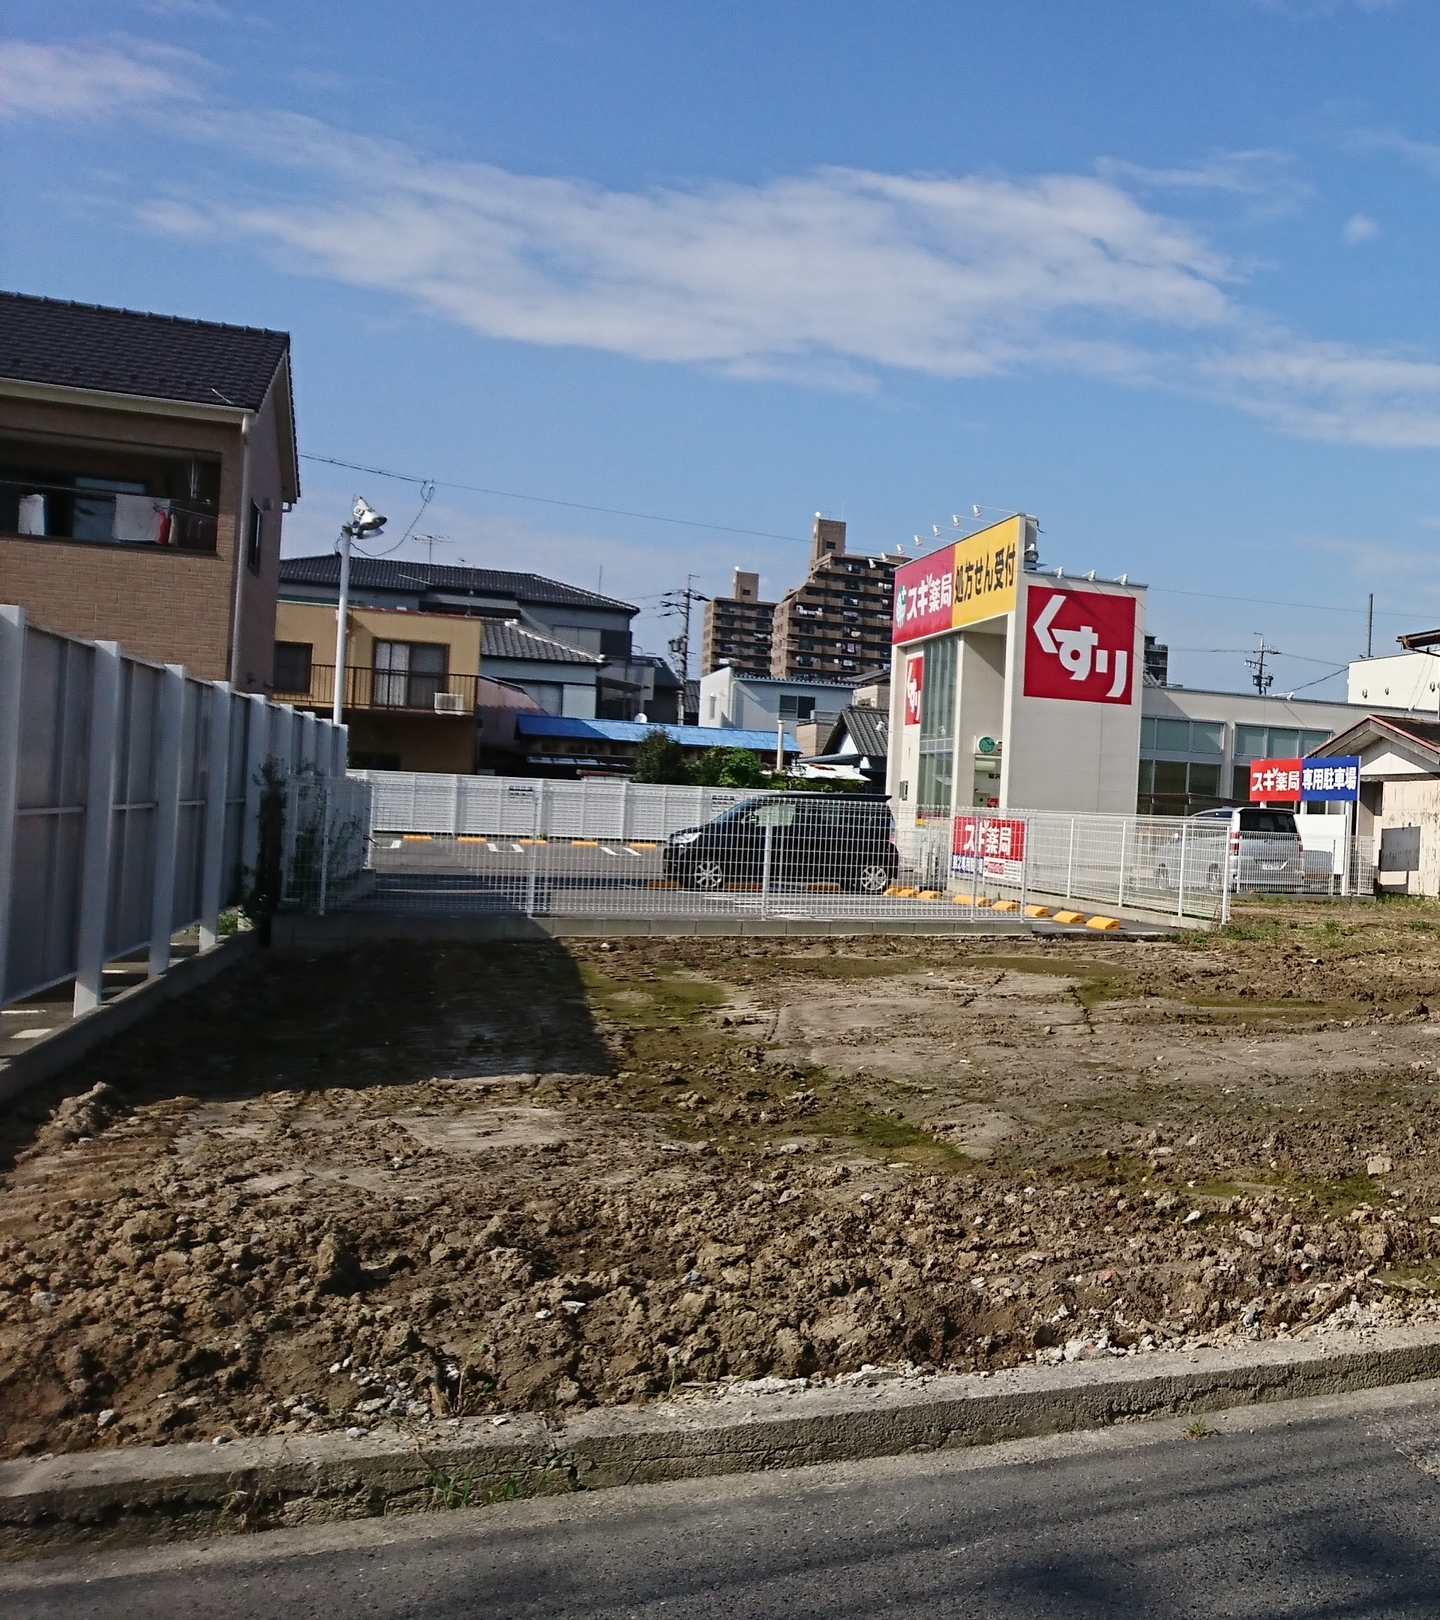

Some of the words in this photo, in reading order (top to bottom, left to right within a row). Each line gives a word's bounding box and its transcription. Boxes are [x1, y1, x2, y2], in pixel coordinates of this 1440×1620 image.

[907, 573, 952, 620] スギ薬局
[955, 543, 1015, 604] 処方せん受付
[1033, 594, 1127, 698] くすり
[907, 662, 921, 720] くすり
[1252, 767, 1300, 791] スギ薬局
[1302, 766, 1357, 791] 専用駐車場
[963, 820, 1012, 855] スギ薬局
